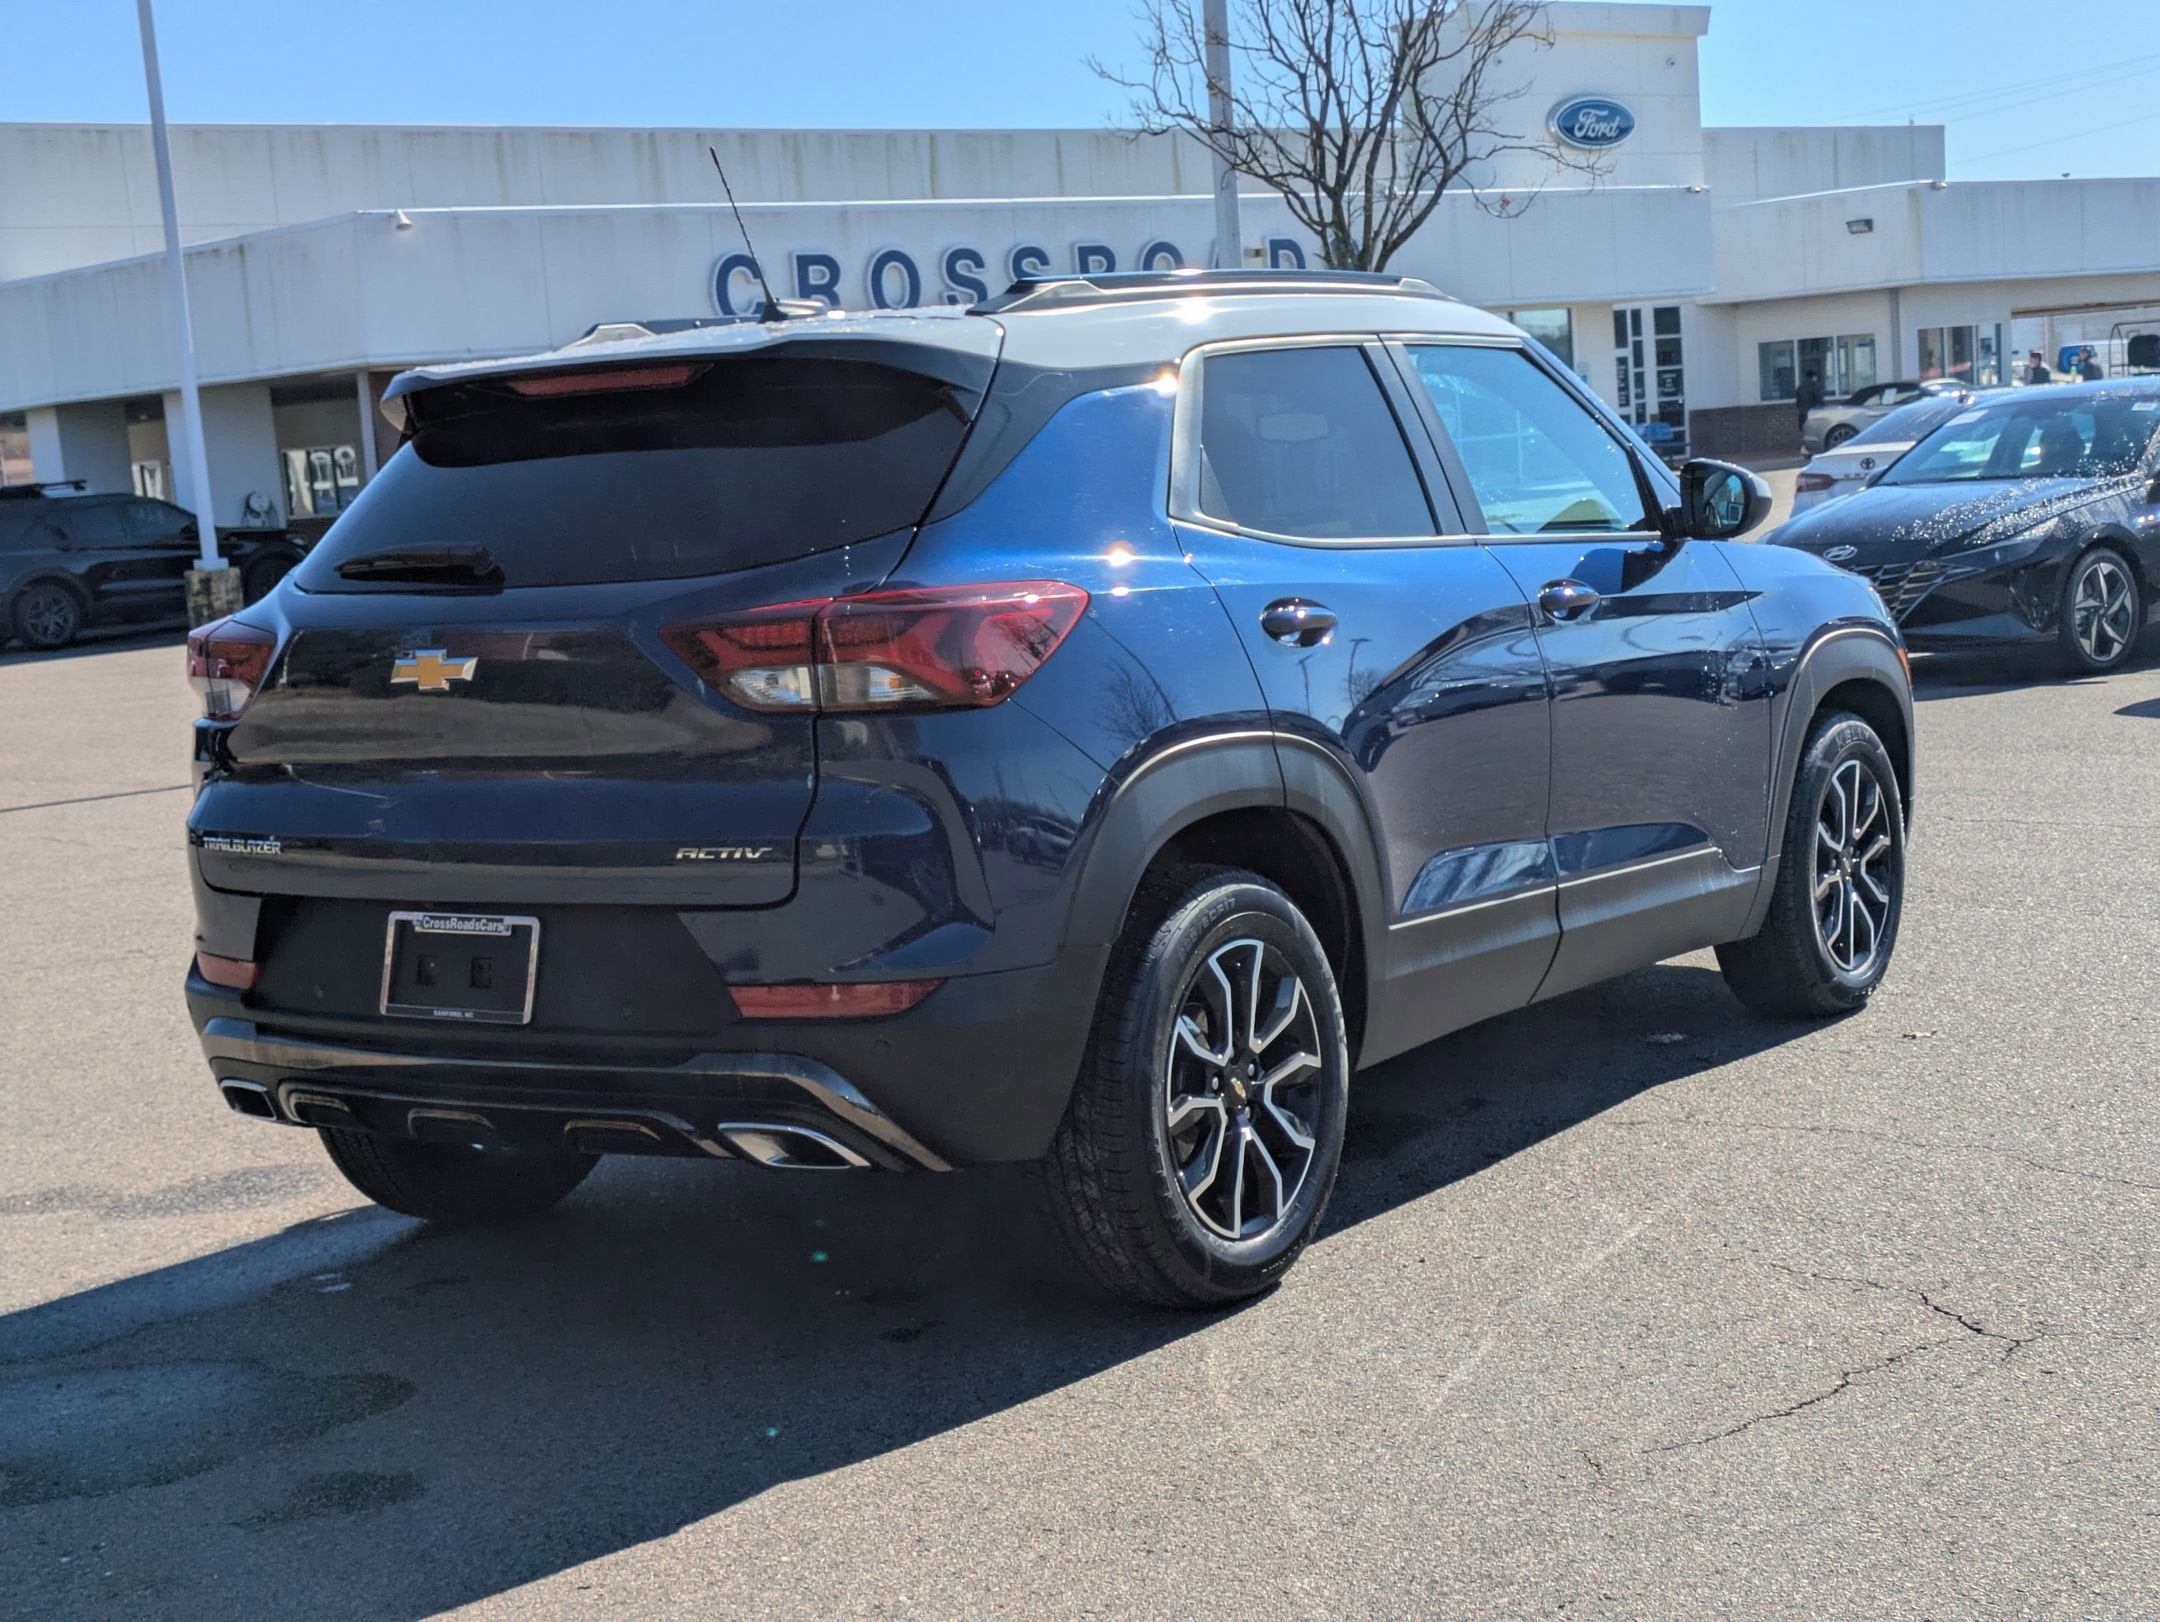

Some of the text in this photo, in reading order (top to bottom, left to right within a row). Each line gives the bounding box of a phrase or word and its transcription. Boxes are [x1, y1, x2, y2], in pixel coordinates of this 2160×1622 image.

[1574, 108, 1620, 138] Ford
[715, 239, 1360, 317] CROSSOD
[202, 836, 281, 855] TRAILBLAZER
[676, 847, 773, 859] ACTIV
